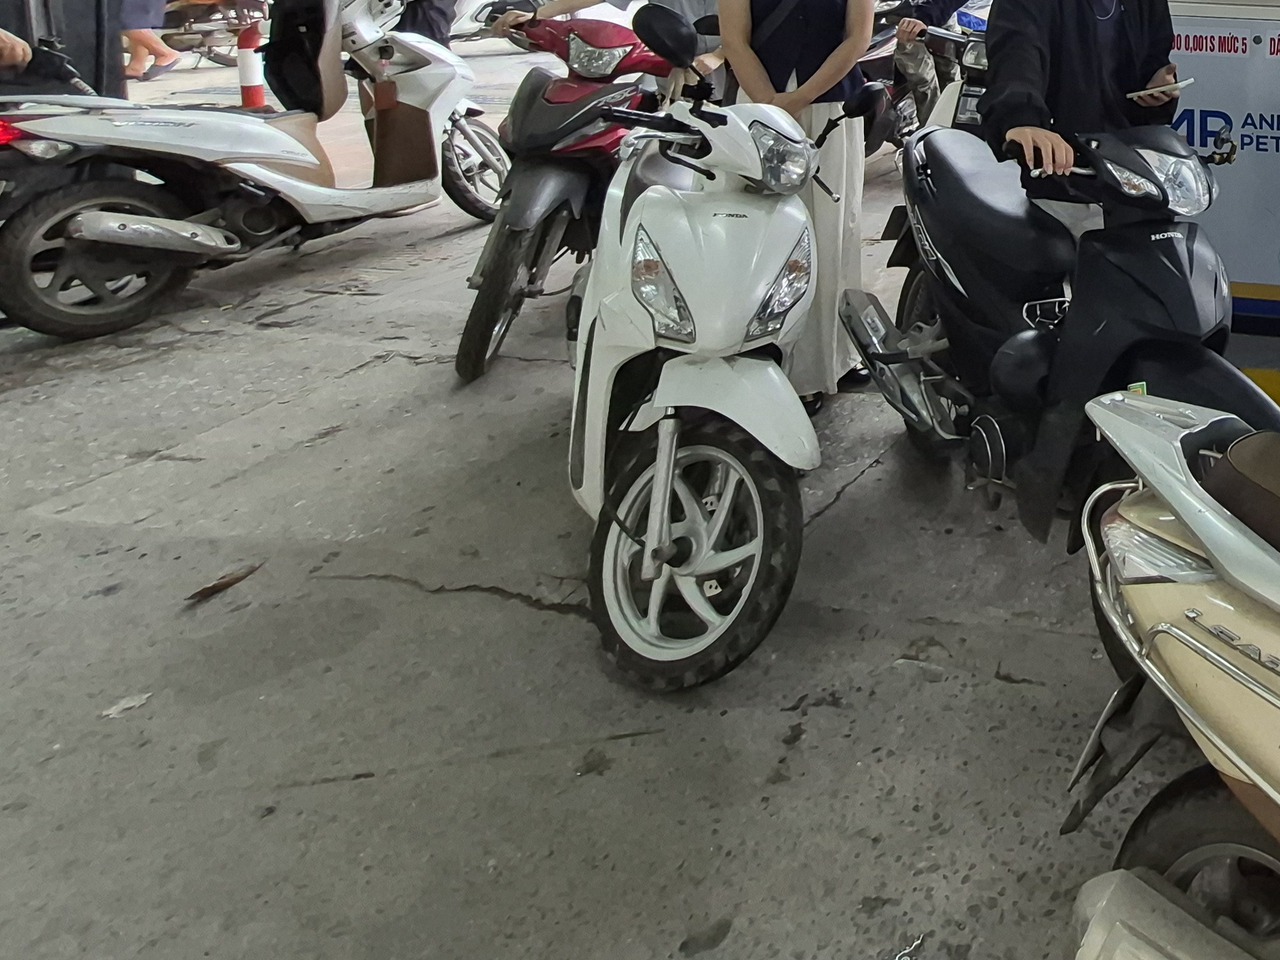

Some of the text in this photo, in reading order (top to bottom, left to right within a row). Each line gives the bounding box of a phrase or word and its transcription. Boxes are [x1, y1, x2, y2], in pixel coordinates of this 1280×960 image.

[1184, 34, 1215, 53] 0,001S
[1218, 32, 1239, 54] MỨC
[1241, 36, 1247, 54] 5
